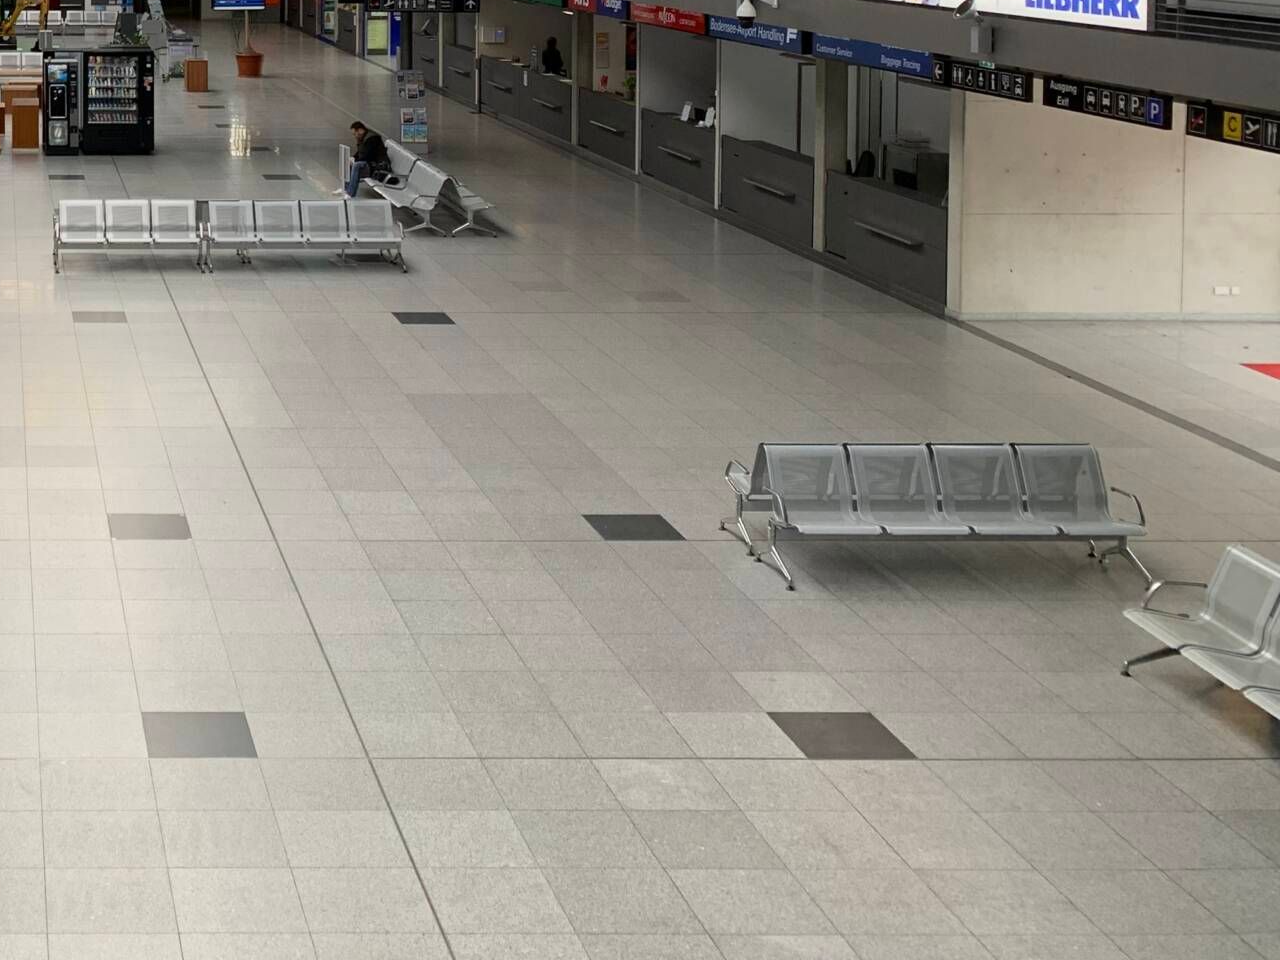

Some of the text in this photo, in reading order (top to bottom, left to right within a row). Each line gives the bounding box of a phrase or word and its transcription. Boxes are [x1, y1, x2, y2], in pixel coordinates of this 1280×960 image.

[758, 26, 785, 45] Handling
[816, 43, 853, 58] Customer Service
[881, 54, 902, 68] Baggage
[1050, 80, 1077, 96] Ausgang
[1056, 95, 1069, 107] Exit
[1132, 97, 1139, 113] P
[1151, 103, 1159, 119] P
[1228, 117, 1237, 132] C
